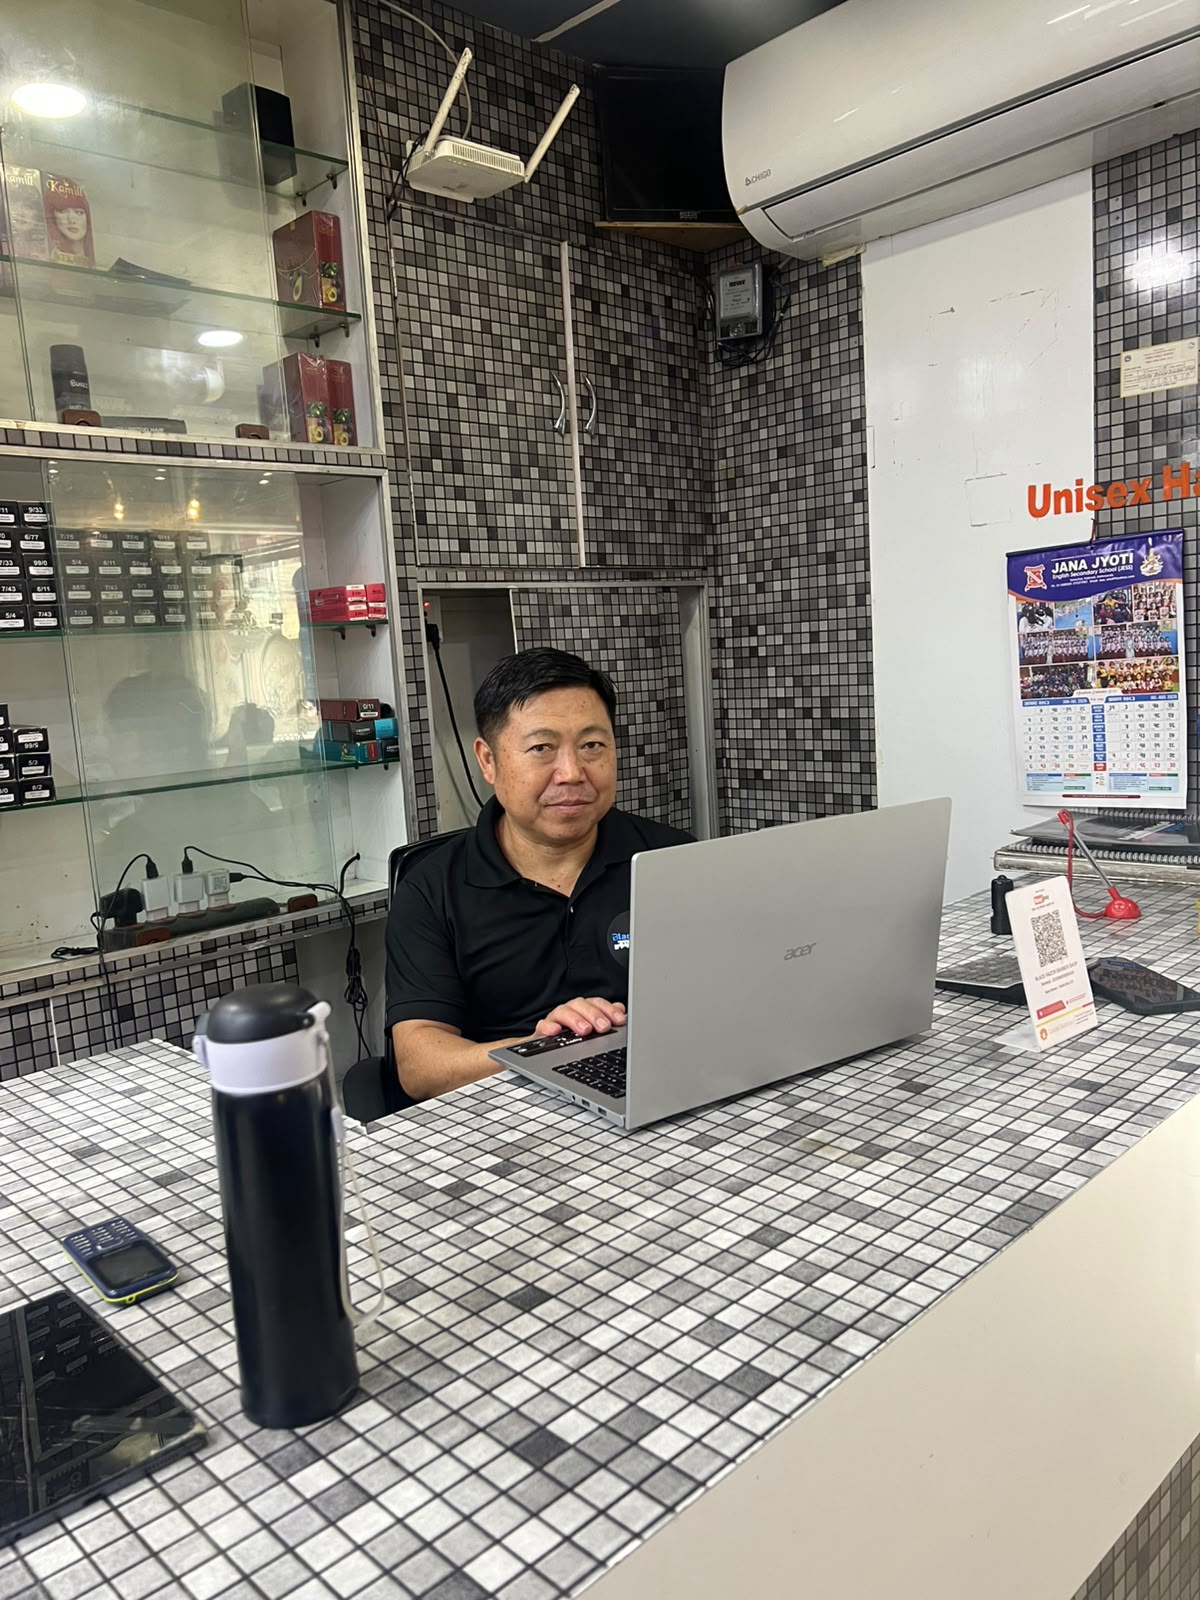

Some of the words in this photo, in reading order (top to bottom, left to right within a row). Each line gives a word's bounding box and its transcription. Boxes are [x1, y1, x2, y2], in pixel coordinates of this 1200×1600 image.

[46, 180, 83, 197] Kamill
[1028, 476, 1153, 518] Unisex
[1051, 559, 1088, 574] JANA
[1091, 552, 1133, 569] JYOTI
[1070, 568, 1099, 579] Secondary
[1099, 566, 1117, 576] School
[784, 942, 817, 960] acer
